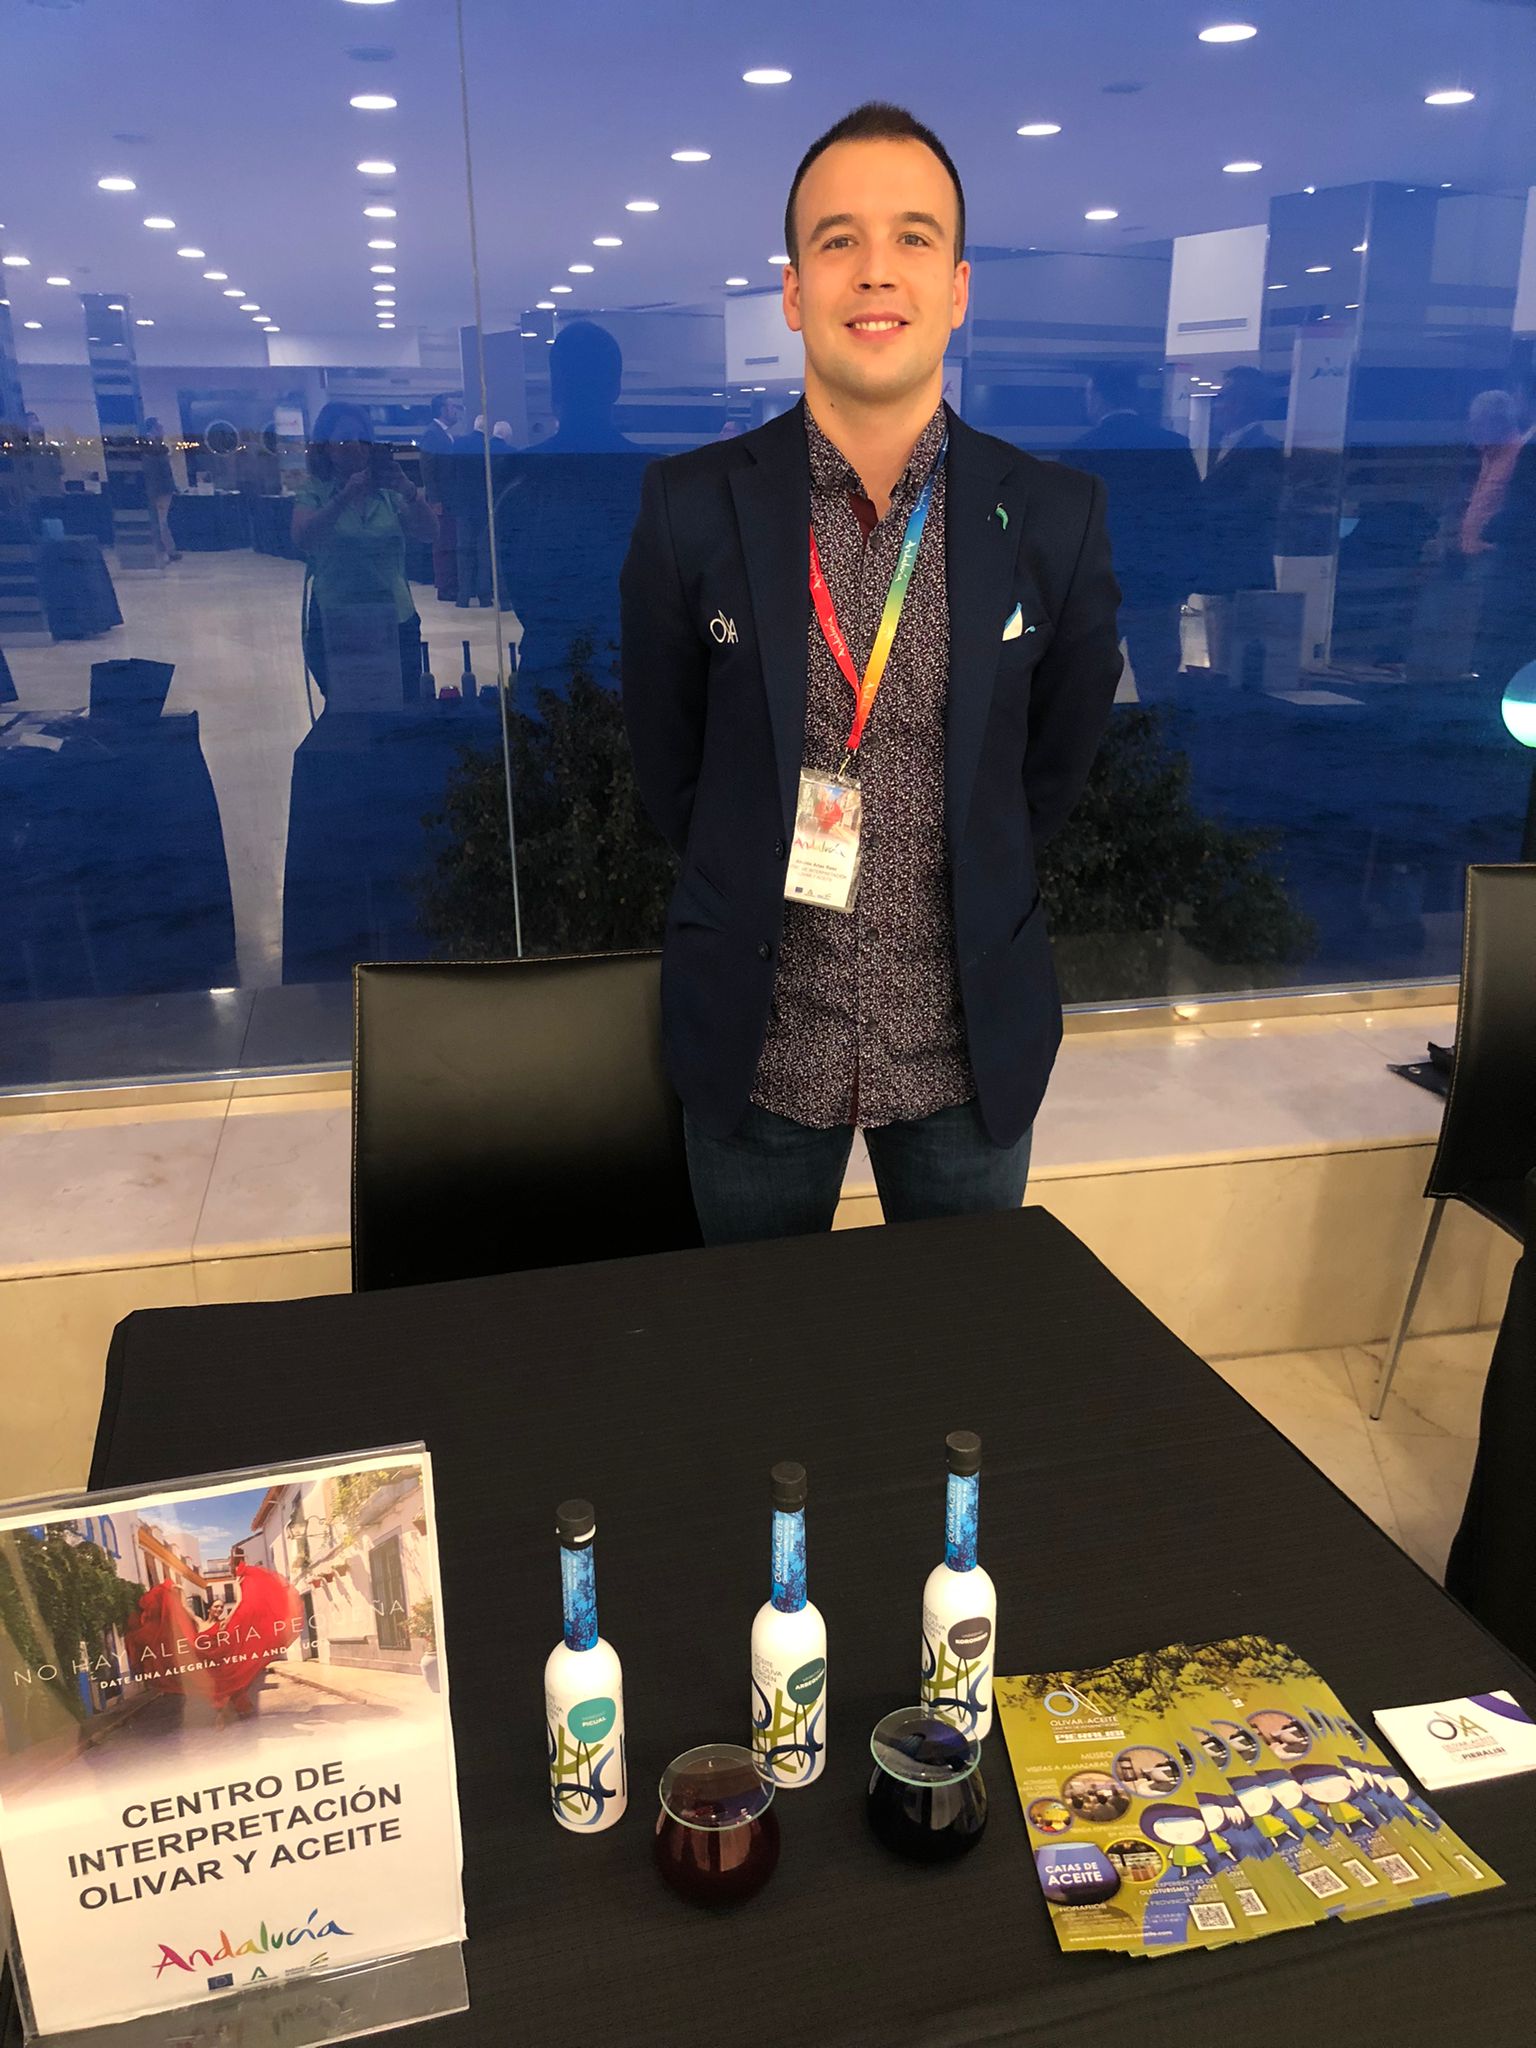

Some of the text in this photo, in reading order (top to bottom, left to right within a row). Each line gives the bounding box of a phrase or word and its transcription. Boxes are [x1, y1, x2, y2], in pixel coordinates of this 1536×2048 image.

[14, 1599, 406, 1686] NO HAY ALEGRÍA PEQÑA
[100, 1676, 131, 1689] DATE
[135, 1671, 161, 1682] UNA
[223, 1653, 247, 1665] VEN
[251, 1652, 259, 1660] A
[582, 1716, 607, 1727] PICUAL
[1080, 1751, 1113, 1760] MUSEO
[1461, 1747, 1506, 1760] PIERALISI
[122, 1761, 345, 1829] CENTRO DE
[67, 1784, 402, 1878] INTERPRETACIÓN
[79, 1818, 402, 1910] OLIVAR Y ACEITE
[1045, 1862, 1098, 1874] CATAS DE
[1048, 1871, 1103, 1886] ACEITE
[152, 1908, 354, 1979] Andalucía
